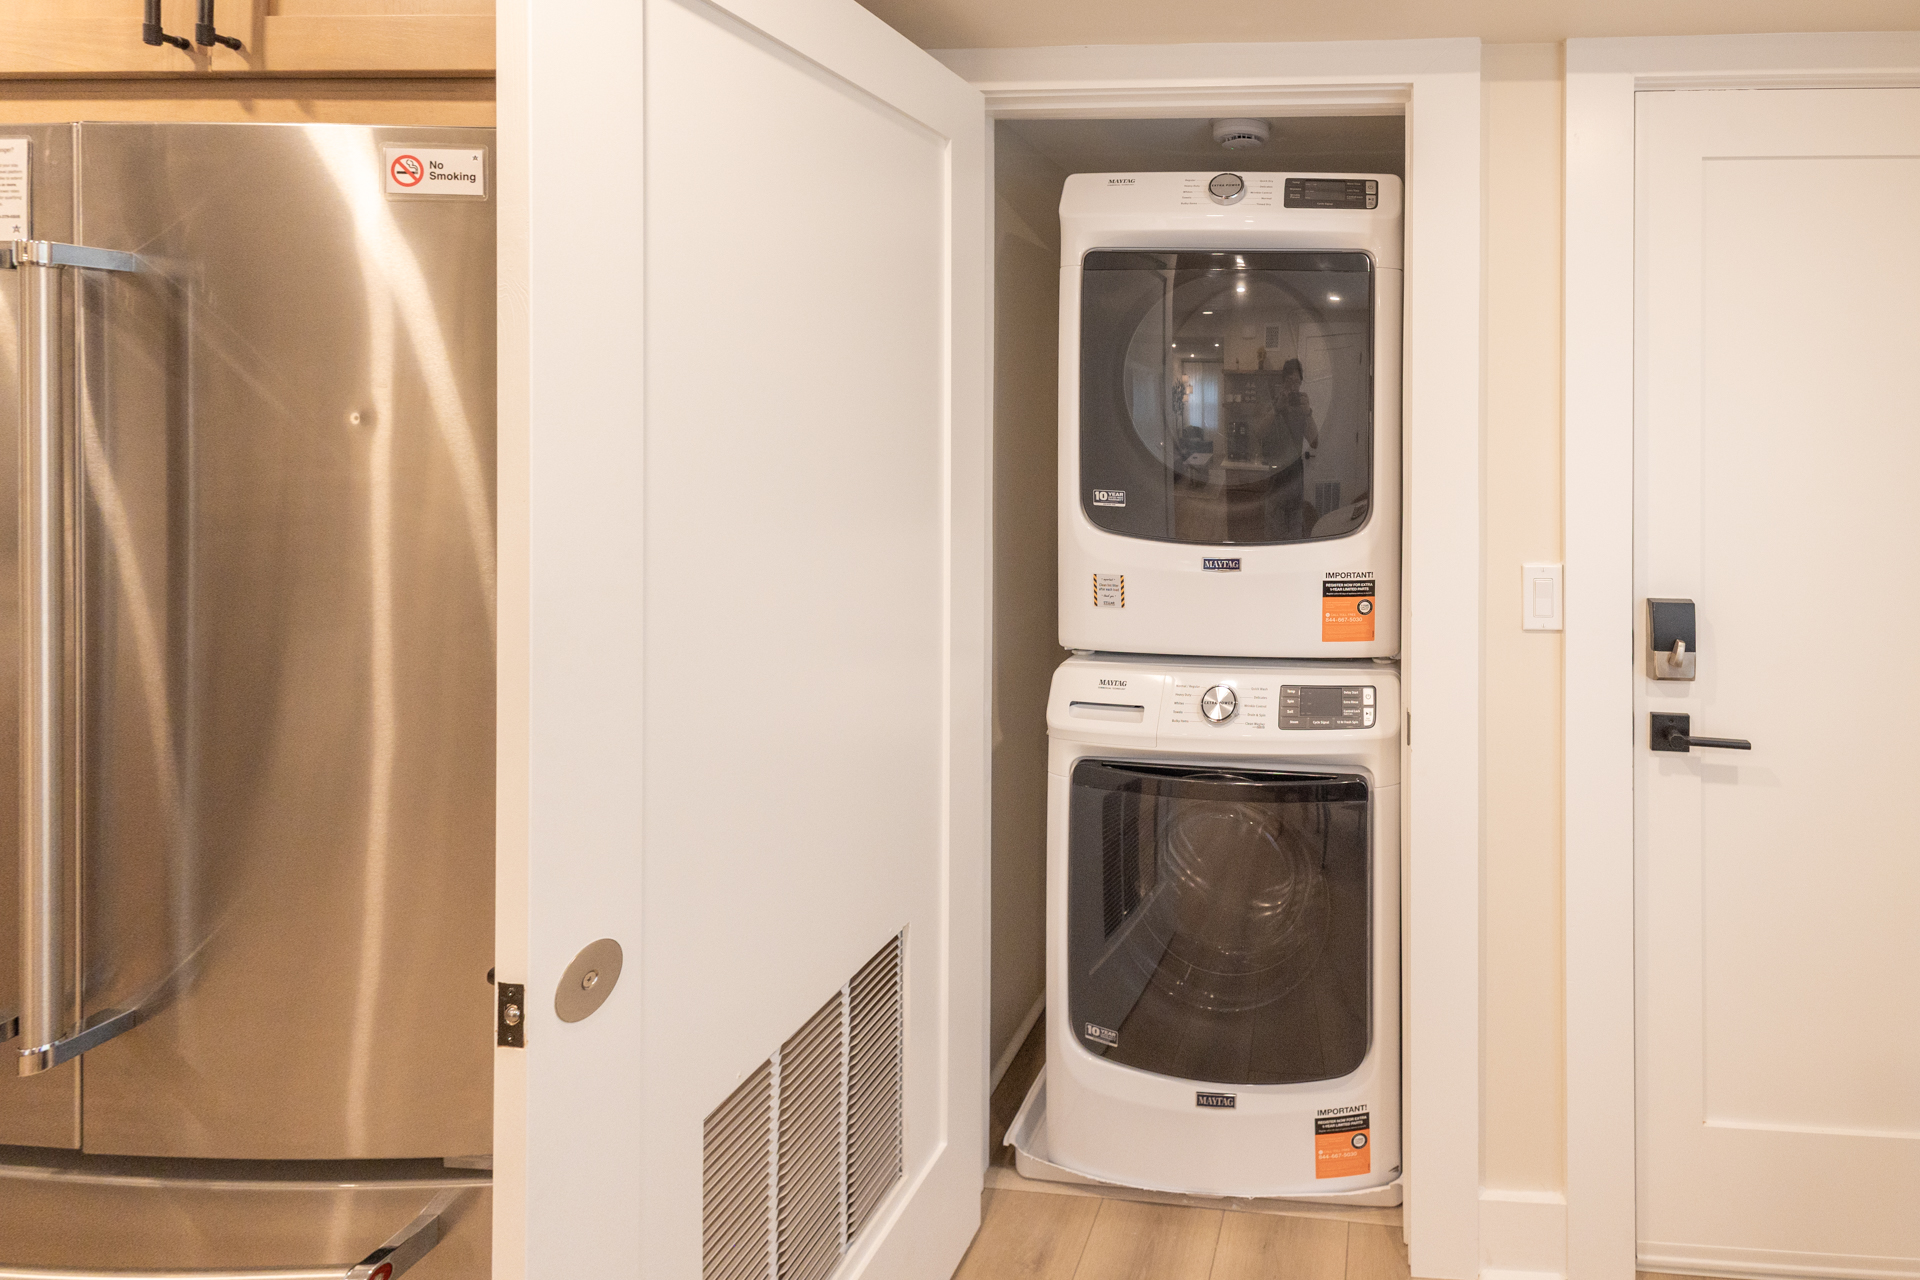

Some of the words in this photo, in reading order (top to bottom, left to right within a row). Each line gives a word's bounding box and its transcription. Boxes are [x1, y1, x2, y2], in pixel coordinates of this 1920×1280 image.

[430, 161, 444, 169] No
[430, 171, 476, 183] Smoking
[1095, 491, 1108, 501] 10
[1088, 1025, 1100, 1036] 10
[1199, 1096, 1234, 1106] MAYTAG
[1317, 1104, 1367, 1116] IMPORTANT!
